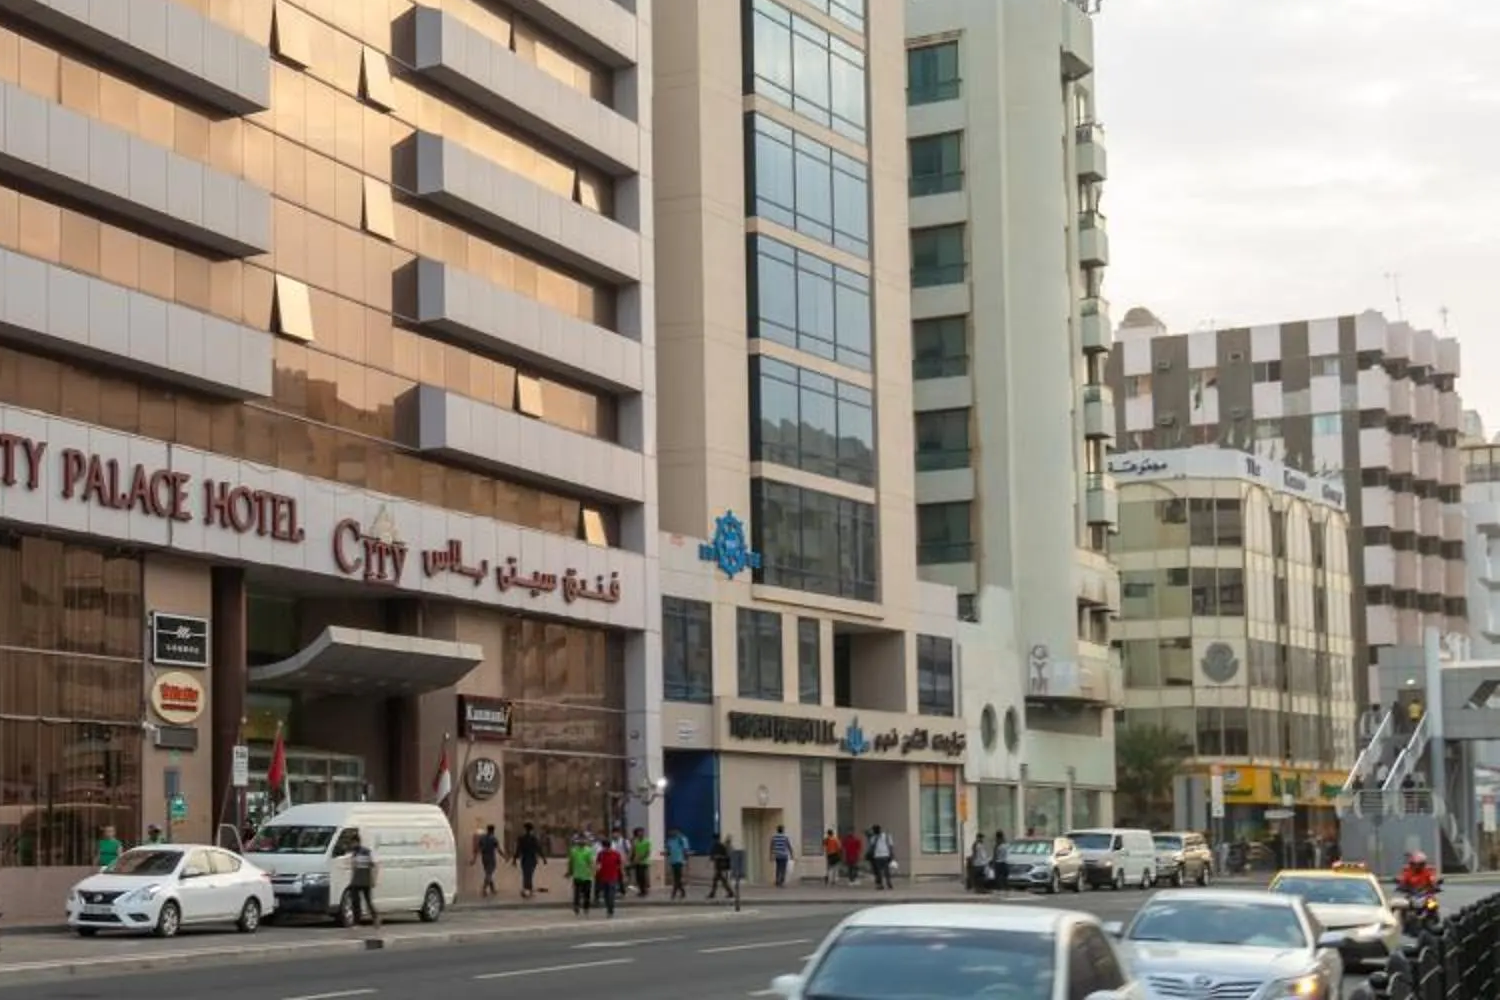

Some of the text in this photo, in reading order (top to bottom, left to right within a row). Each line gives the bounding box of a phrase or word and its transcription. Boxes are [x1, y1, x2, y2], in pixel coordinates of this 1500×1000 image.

[62, 448, 192, 522] PALACE
[204, 479, 305, 543] HOTEL
[562, 568, 620, 604] فندق
